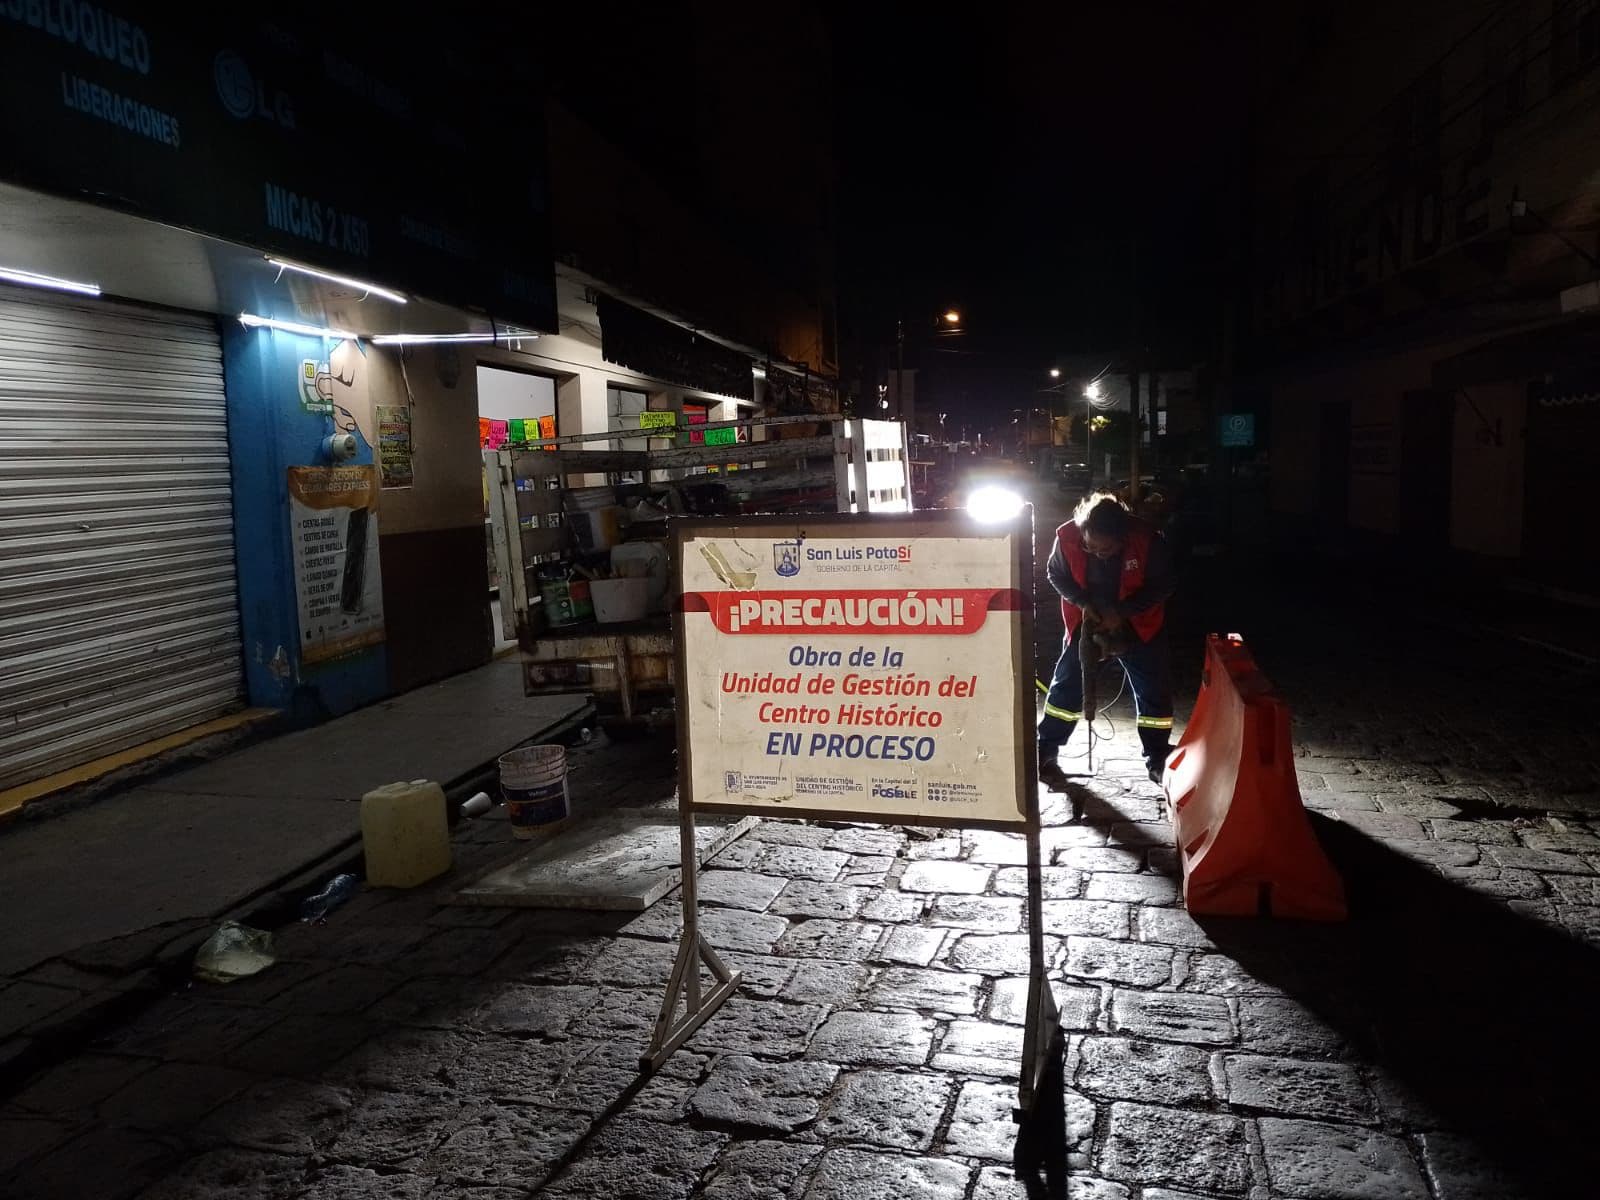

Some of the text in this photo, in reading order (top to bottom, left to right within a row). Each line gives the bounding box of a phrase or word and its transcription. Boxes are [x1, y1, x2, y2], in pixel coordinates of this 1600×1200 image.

[61, 71, 182, 150] LIBERACIONES
[255, 80, 297, 129] LG
[264, 179, 324, 246] MICAS
[327, 205, 338, 249] 2
[807, 548, 832, 561] San
[836, 546, 863, 560] Luis
[816, 563, 903, 573] GOBIERNO DE LA CAPITAL
[730, 592, 964, 632] ¡PRECAUCIÓN!
[789, 646, 904, 668] Obra de la
[722, 672, 977, 698] Unidad de Gestión del
[758, 702, 942, 728] Centro Histórico
[766, 732, 936, 762] EN PROCESO
[829, 777, 854, 785] GESTIÓN
[833, 783, 863, 791] HISTÓRICO
[928, 781, 977, 790] sanluis.gob.mx
